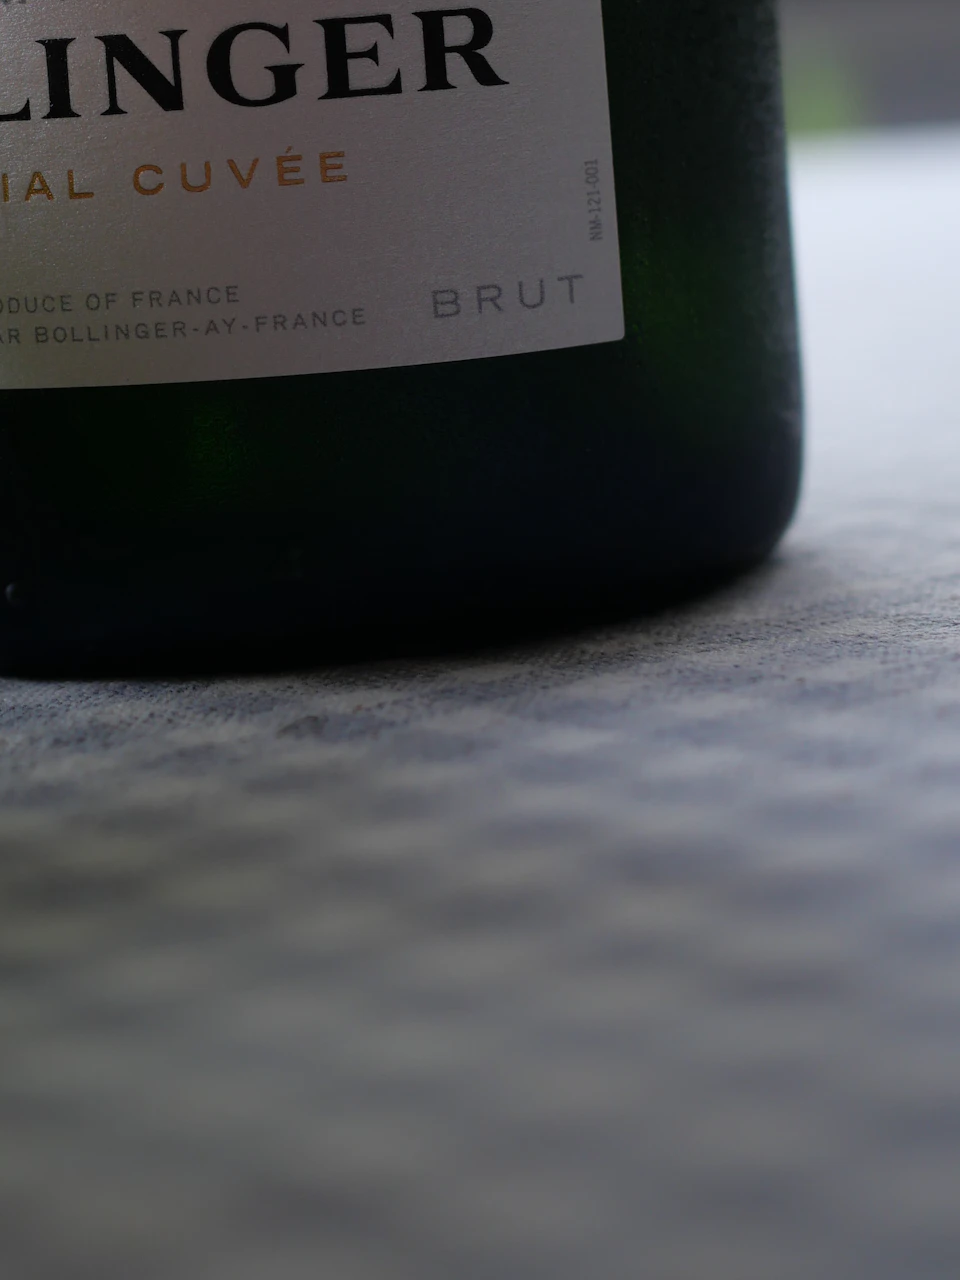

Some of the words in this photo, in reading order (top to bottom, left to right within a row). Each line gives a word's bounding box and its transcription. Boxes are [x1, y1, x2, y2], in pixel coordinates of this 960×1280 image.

[132, 146, 349, 197] CUVÉE
[583, 158, 603, 242] NM-121-001
[85, 292, 118, 312] OF
[131, 284, 241, 309] FRANCE
[432, 273, 585, 320] BRUT
